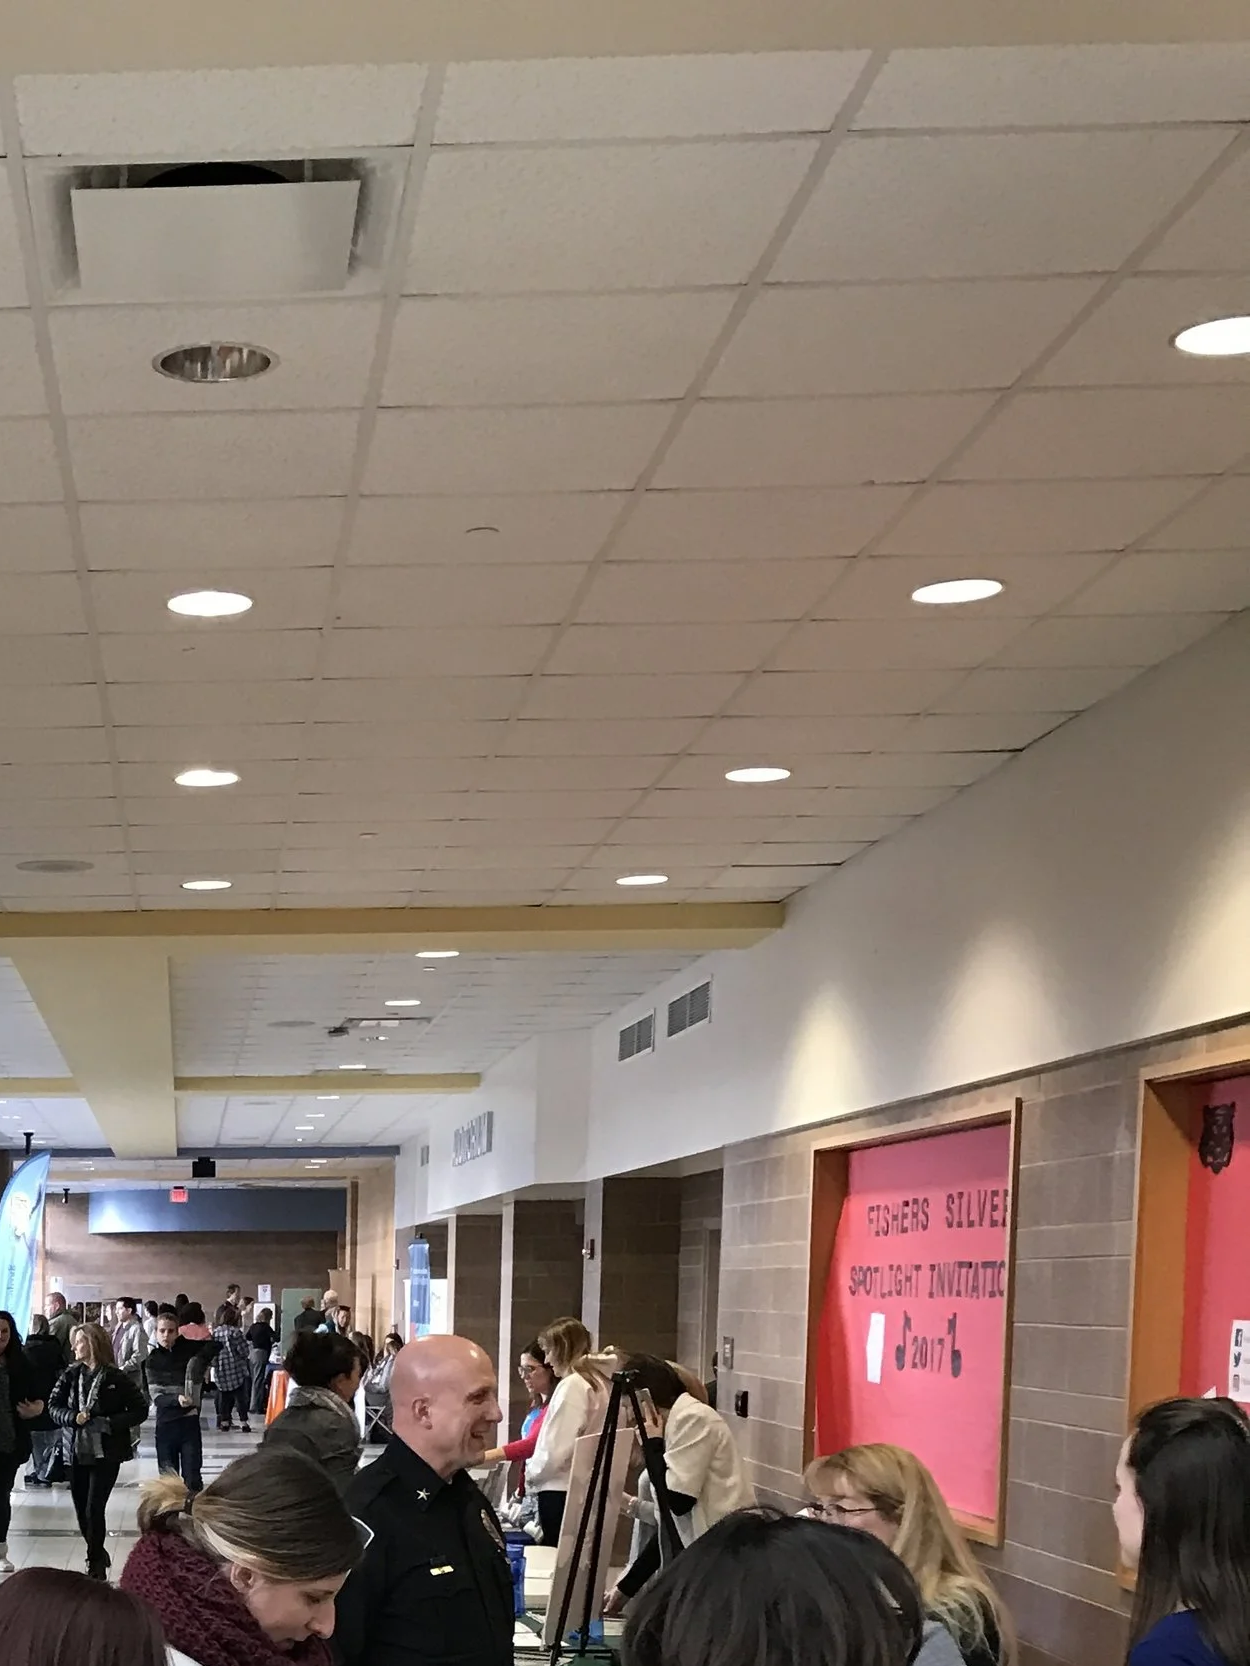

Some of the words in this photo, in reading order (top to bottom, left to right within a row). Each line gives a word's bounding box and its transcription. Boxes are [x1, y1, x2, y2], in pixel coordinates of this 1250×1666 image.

[867, 1197, 930, 1237] FISHERS
[848, 1263, 922, 1300] SPOTLIGHT
[911, 1335, 946, 1374] 2017
